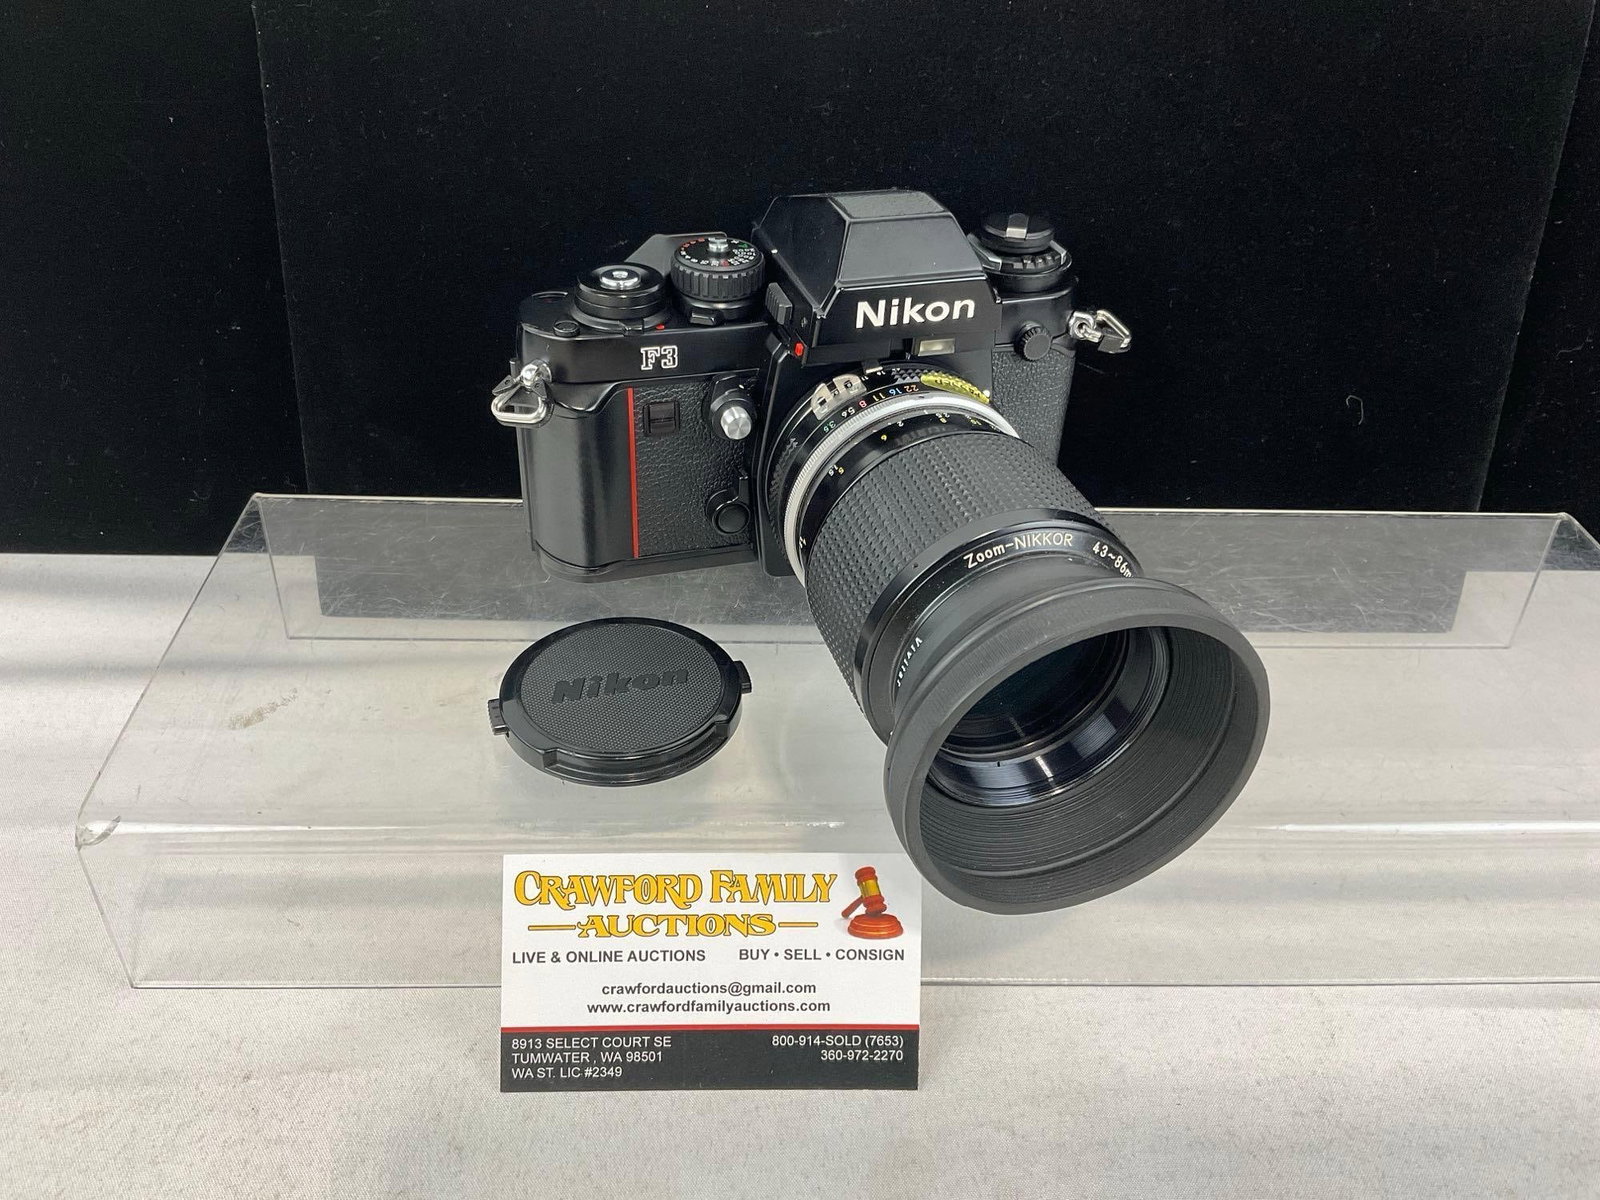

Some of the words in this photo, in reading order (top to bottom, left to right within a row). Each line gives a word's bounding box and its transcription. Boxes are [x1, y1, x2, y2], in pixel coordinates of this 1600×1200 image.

[856, 297, 976, 328] Nikon
[640, 345, 678, 370] F3
[888, 388, 902, 396] 16
[904, 384, 919, 392] 22
[872, 392, 886, 402] 11
[859, 400, 867, 408] 8
[841, 406, 856, 418] 5.6
[963, 532, 1074, 568] Zoom-NIKKOR
[1092, 541, 1133, 578] 43~86m
[552, 668, 689, 705] Nikon
[514, 870, 703, 910] CRAWFORD
[710, 870, 838, 906] FAMILY
[577, 914, 776, 938] AUCTIONS
[512, 952, 546, 964] LIVE
[550, 952, 560, 963] &
[566, 950, 623, 963] ONLINE
[628, 950, 706, 962] AUCTIONS
[739, 949, 770, 960] BUY
[784, 949, 822, 960] SELL
[836, 949, 904, 960] CONSIGN
[602, 982, 816, 996] crawfordauctions@gmail.com
[587, 1000, 830, 1014] www.crawfordfamilyauctions.com
[512, 1038, 542, 1049] 8913
[546, 1038, 598, 1048] SELECT
[602, 1036, 650, 1048] COURT
[654, 1036, 672, 1047] SE
[772, 1035, 862, 1046] 800-914-SOLD
[865, 1035, 904, 1048] (7653)
[600, 1052, 622, 1062] WA
[626, 1051, 662, 1062] 98501
[820, 1050, 904, 1061] 360-972-2270
[512, 1068, 534, 1078] WA
[536, 1067, 556, 1078] ST.
[560, 1067, 580, 1078] LIC
[584, 1066, 622, 1078] #2349
